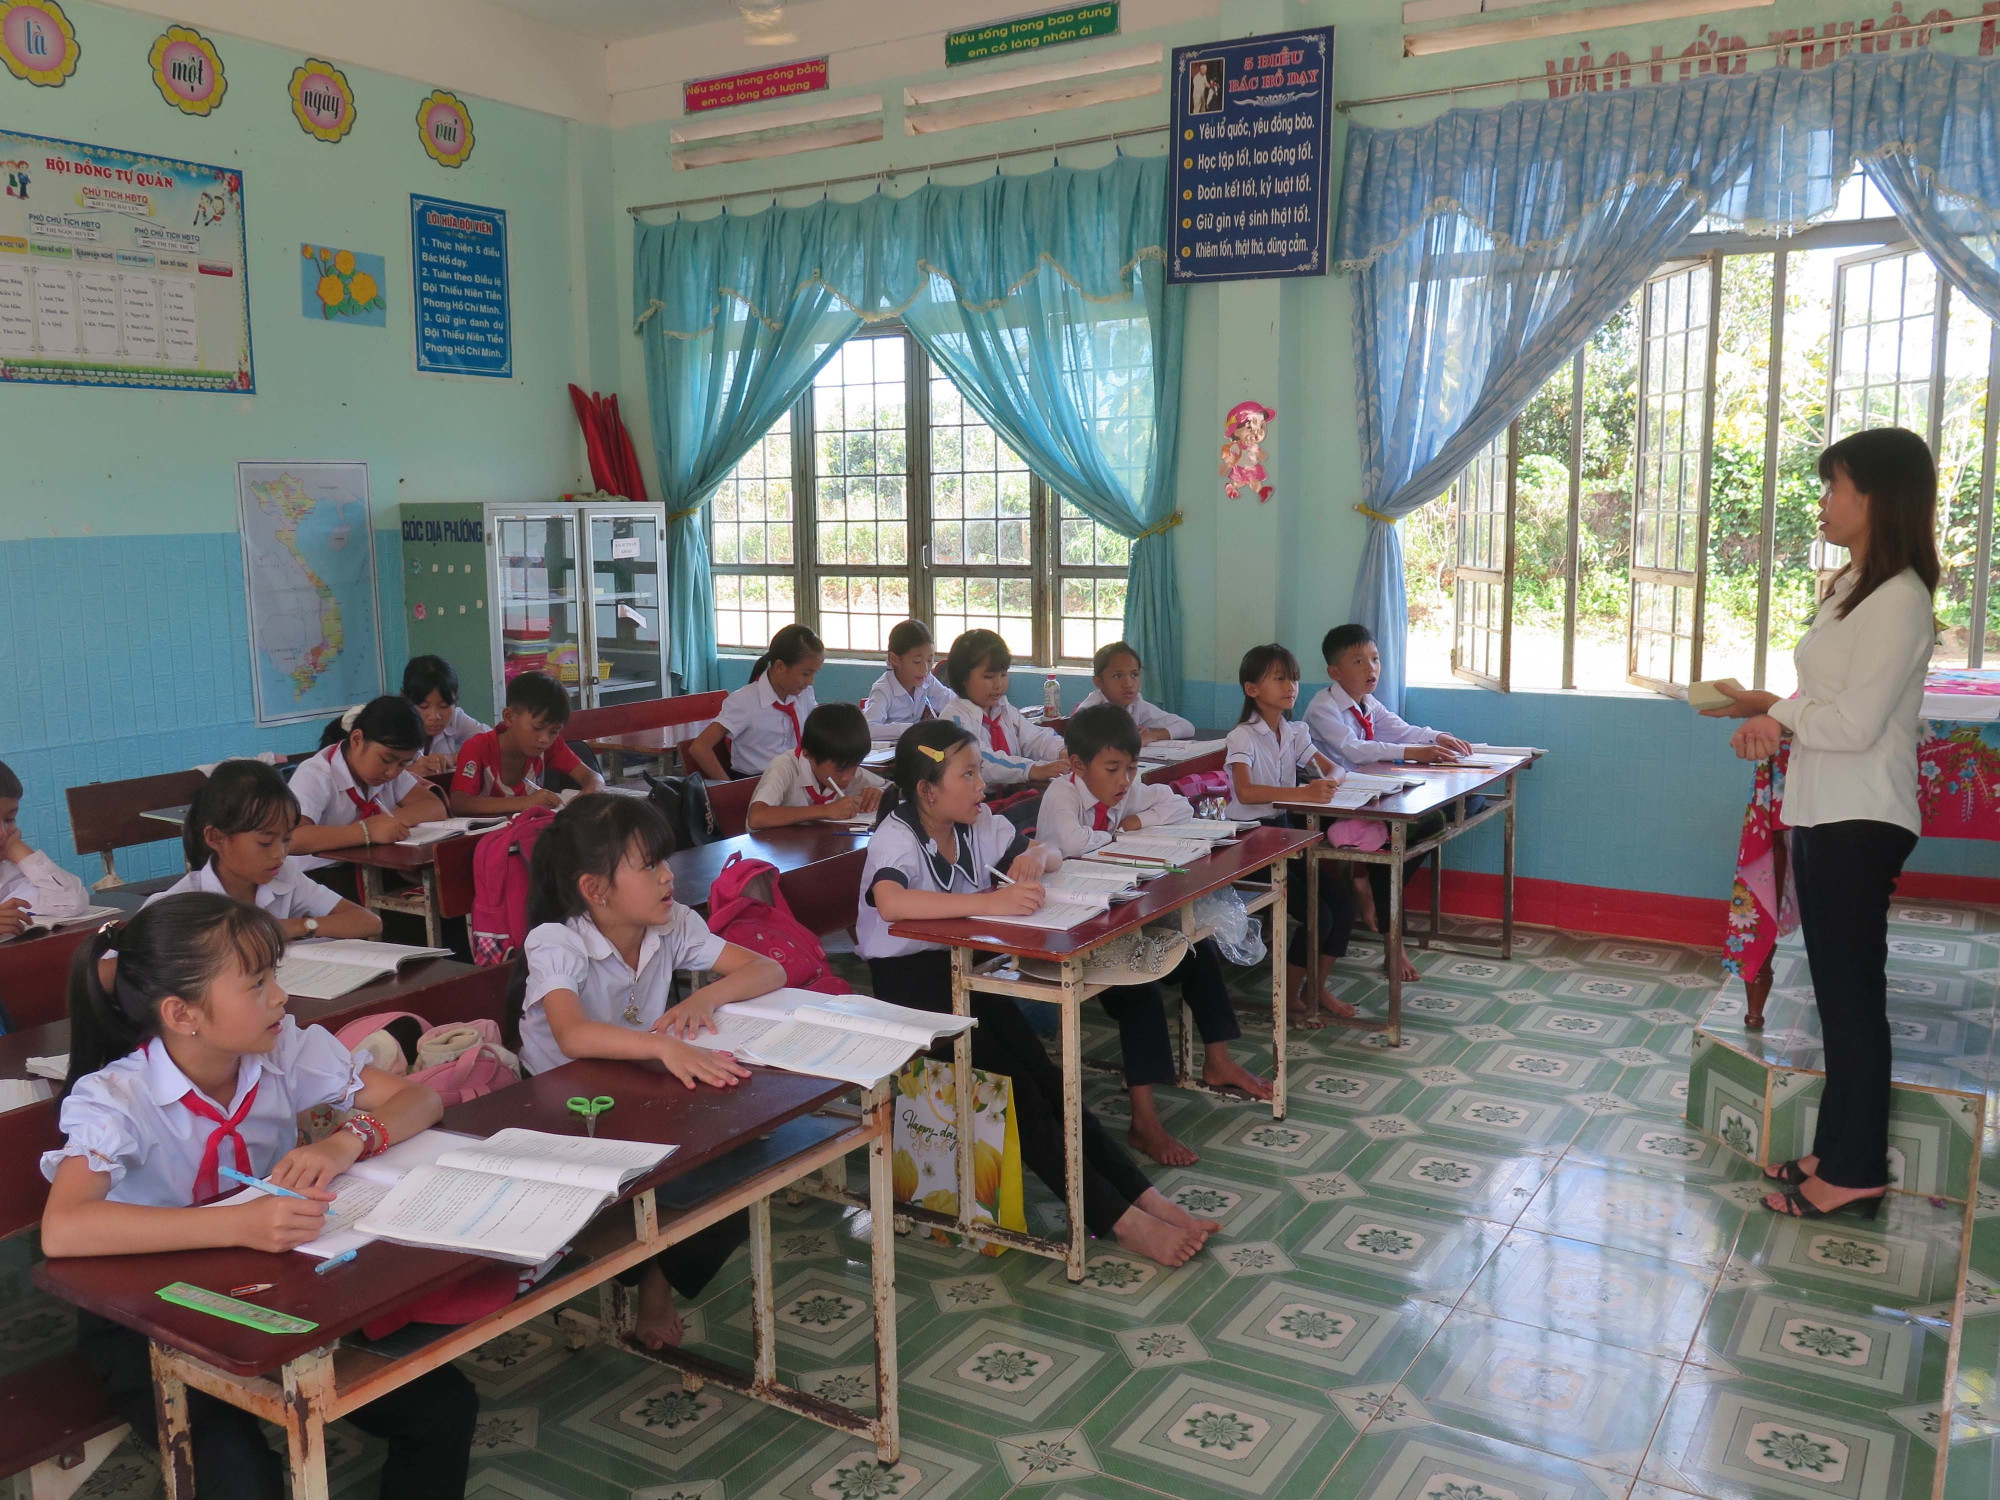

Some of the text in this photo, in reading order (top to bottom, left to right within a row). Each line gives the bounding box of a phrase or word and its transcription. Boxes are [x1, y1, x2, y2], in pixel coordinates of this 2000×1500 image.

[25, 18, 47, 56] là
[950, 5, 1112, 46] Nếu sống trong bao dung
[967, 24, 1093, 58] em có lòng nhân ái
[1244, 45, 1305, 71] 5 ĐIỀU
[172, 55, 205, 93] một
[686, 62, 826, 96] Nếu sống trong công bằng
[1228, 67, 1320, 93] BÁC HỒ DẠY
[304, 85, 340, 120] ngày
[701, 80, 811, 107] em có lòng độ lượng
[435, 118, 458, 143] vui
[1200, 121, 1216, 140] Yêu
[1217, 116, 1226, 138] tổ
[1227, 117, 1251, 141] quốc,
[1253, 117, 1269, 137] yêu
[1271, 112, 1293, 133] đồng
[1295, 111, 1315, 130] bào.
[1198, 153, 1216, 174] Học
[1218, 150, 1235, 171] tập
[1236, 146, 1251, 168] tốt,
[1253, 148, 1269, 164] lao
[1270, 145, 1296, 166] động
[1298, 140, 1314, 160] tốt.
[45, 156, 174, 188] HỘI ĐỒNG TỰ QUẢN
[1197, 183, 1223, 200] Đoàn
[1225, 178, 1241, 198] kết
[1242, 177, 1258, 198] tốt,
[1260, 175, 1272, 198] kỷ
[1274, 176, 1294, 197] luật
[1296, 172, 1312, 192] tốt.
[1196, 213, 1213, 231] Giữ
[1216, 211, 1231, 233] gìn
[1234, 211, 1246, 230] vệ
[1249, 207, 1269, 226] sinh
[1271, 206, 1292, 228] thật
[1293, 203, 1311, 222] tốt.
[422, 237, 501, 258] 1. Thực hiện 5 điều
[1195, 239, 1219, 258] Khiêm
[1219, 236, 1234, 259] tốn,
[1235, 238, 1250, 259] thật
[1251, 237, 1266, 259] thà,
[1267, 237, 1287, 257] dũng
[1288, 233, 1309, 253] cảm.
[422, 252, 469, 269] Bác Hồ dạy.
[422, 267, 430, 277] 2.
[454, 272, 473, 283] theo
[494, 277, 502, 288] lệ
[422, 282, 438, 295] Đội
[439, 284, 463, 296] Thiếu
[464, 288, 483, 299] Niên
[423, 297, 451, 311] Phong
[464, 302, 479, 313] Chí
[479, 304, 503, 315] Minh.
[424, 312, 504, 332] 3. Giữ gìn danh dự
[424, 327, 439, 339] Đội
[441, 328, 465, 341] Thiếu
[466, 332, 485, 343] Niên
[425, 342, 454, 356] Phong
[466, 346, 480, 356] Chí
[481, 347, 504, 359] Minh.
[402, 515, 424, 542] GÓC
[902, 1109, 938, 1143] Happy
